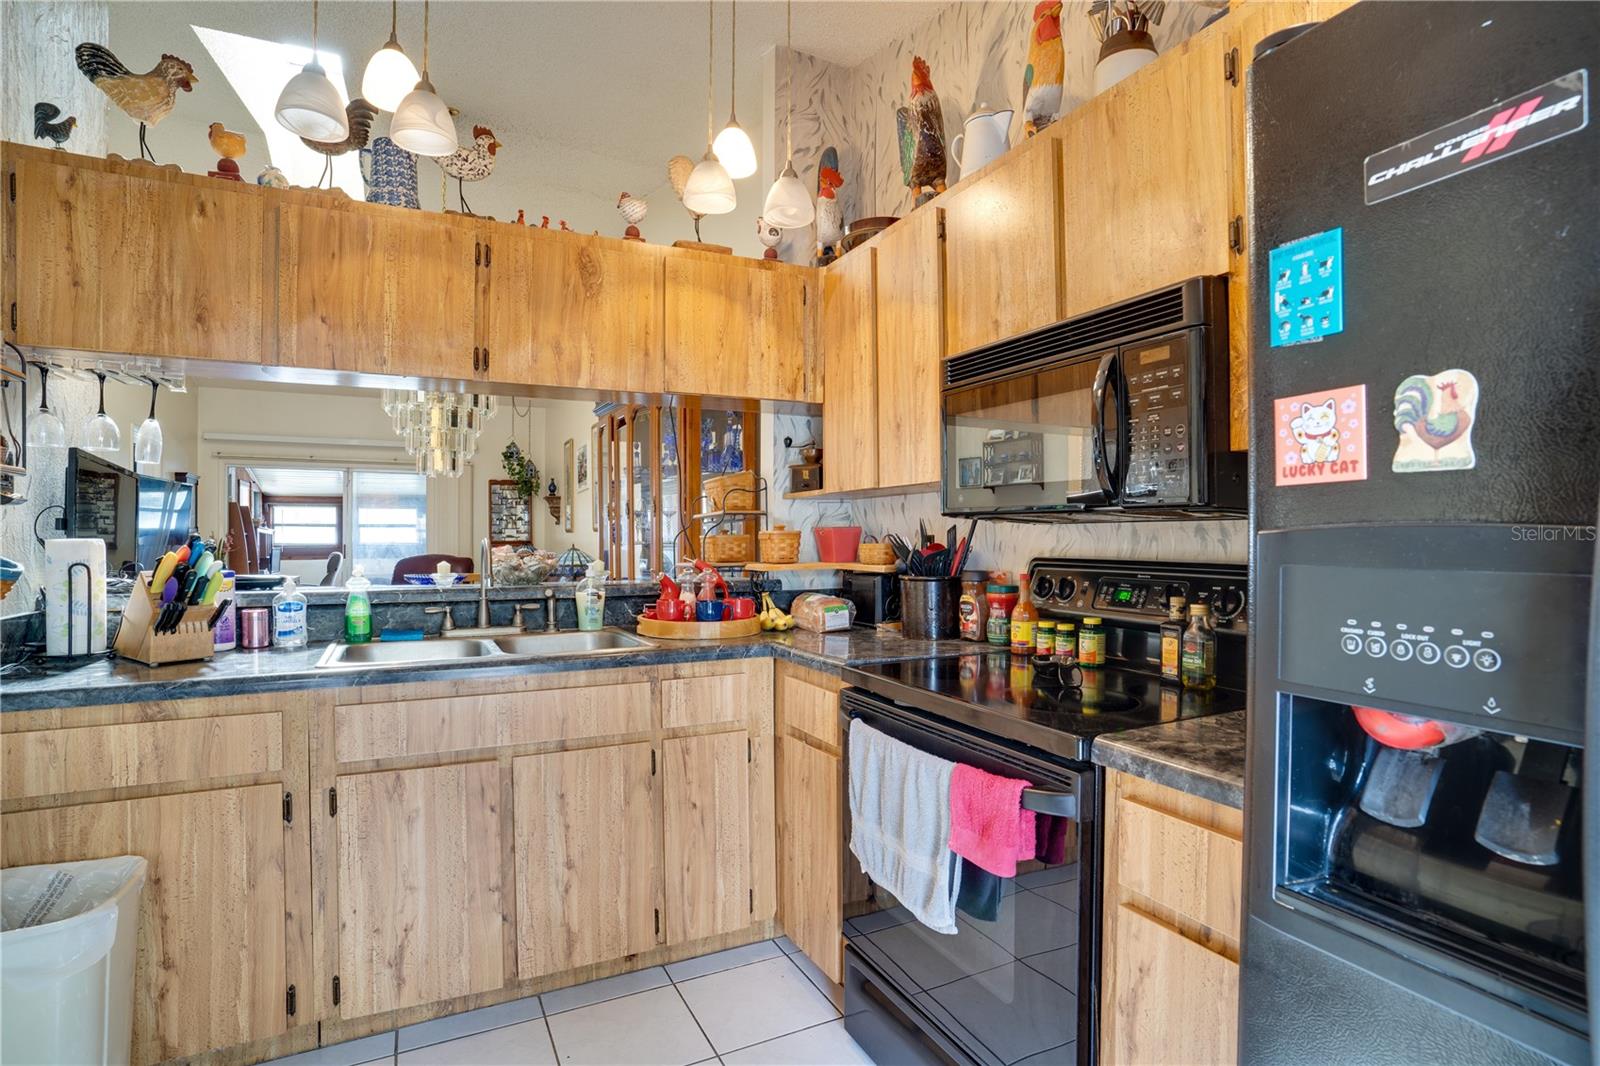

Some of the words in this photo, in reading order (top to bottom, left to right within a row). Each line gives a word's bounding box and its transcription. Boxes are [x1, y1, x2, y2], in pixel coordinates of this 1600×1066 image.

[1368, 95, 1582, 186] CHALLENGER
[1282, 462, 1325, 478] LUCKY
[1330, 460, 1359, 474] CAT
